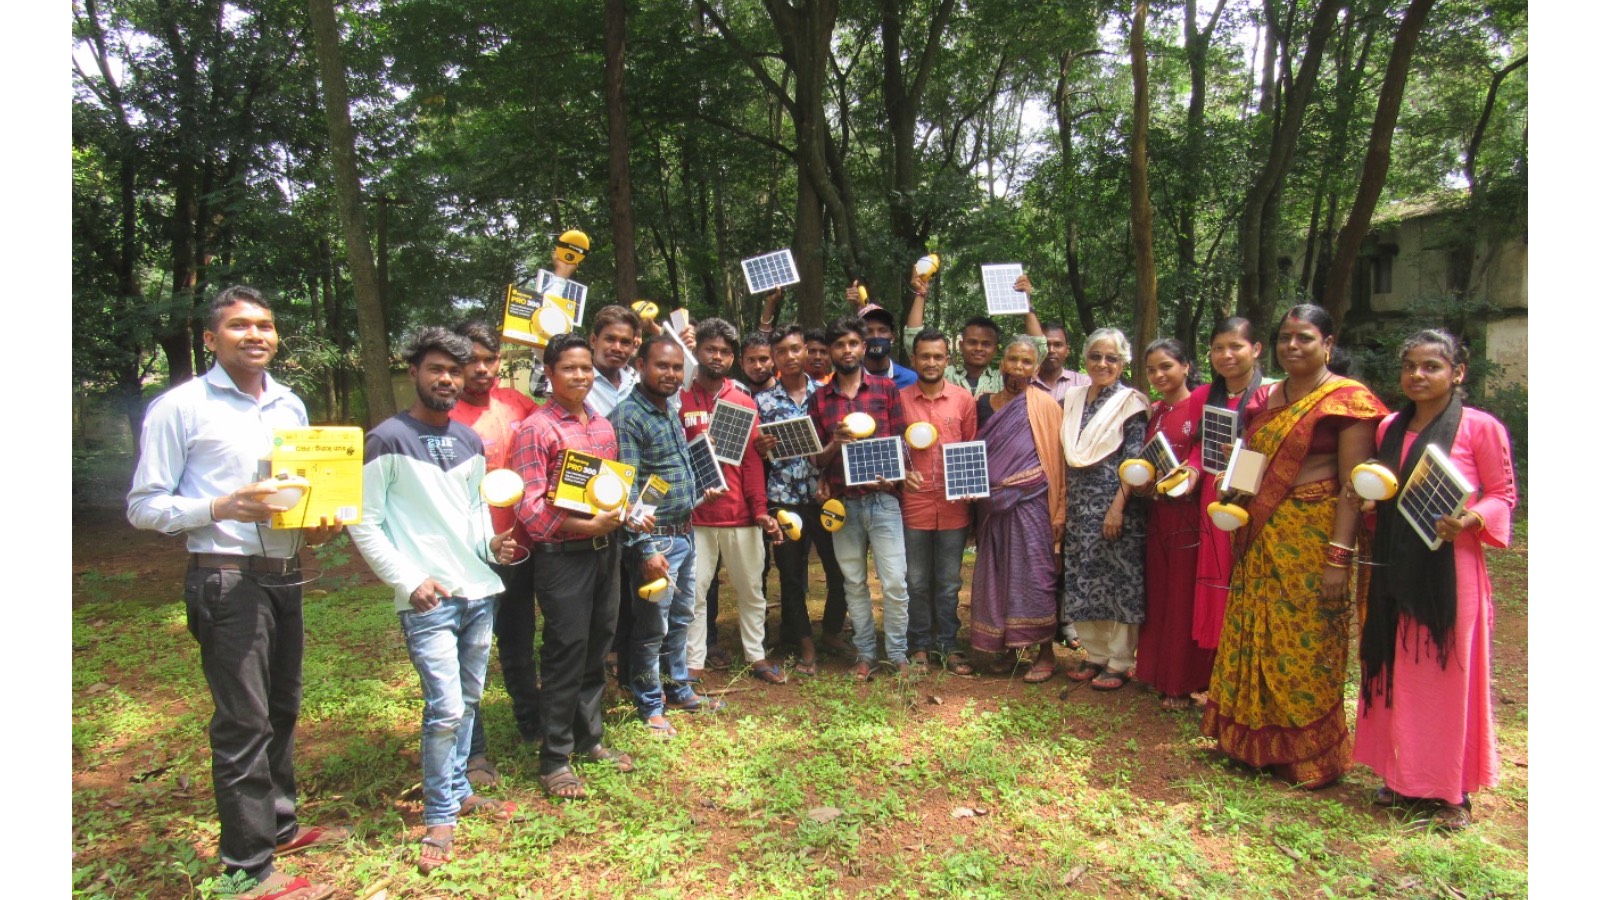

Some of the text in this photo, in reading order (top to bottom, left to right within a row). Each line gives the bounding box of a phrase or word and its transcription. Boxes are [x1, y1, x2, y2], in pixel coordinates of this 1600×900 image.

[511, 296, 541, 308] PRO 300
[685, 416, 697, 428] ON
[567, 462, 583, 472] PRO
[583, 466, 597, 475] 300
